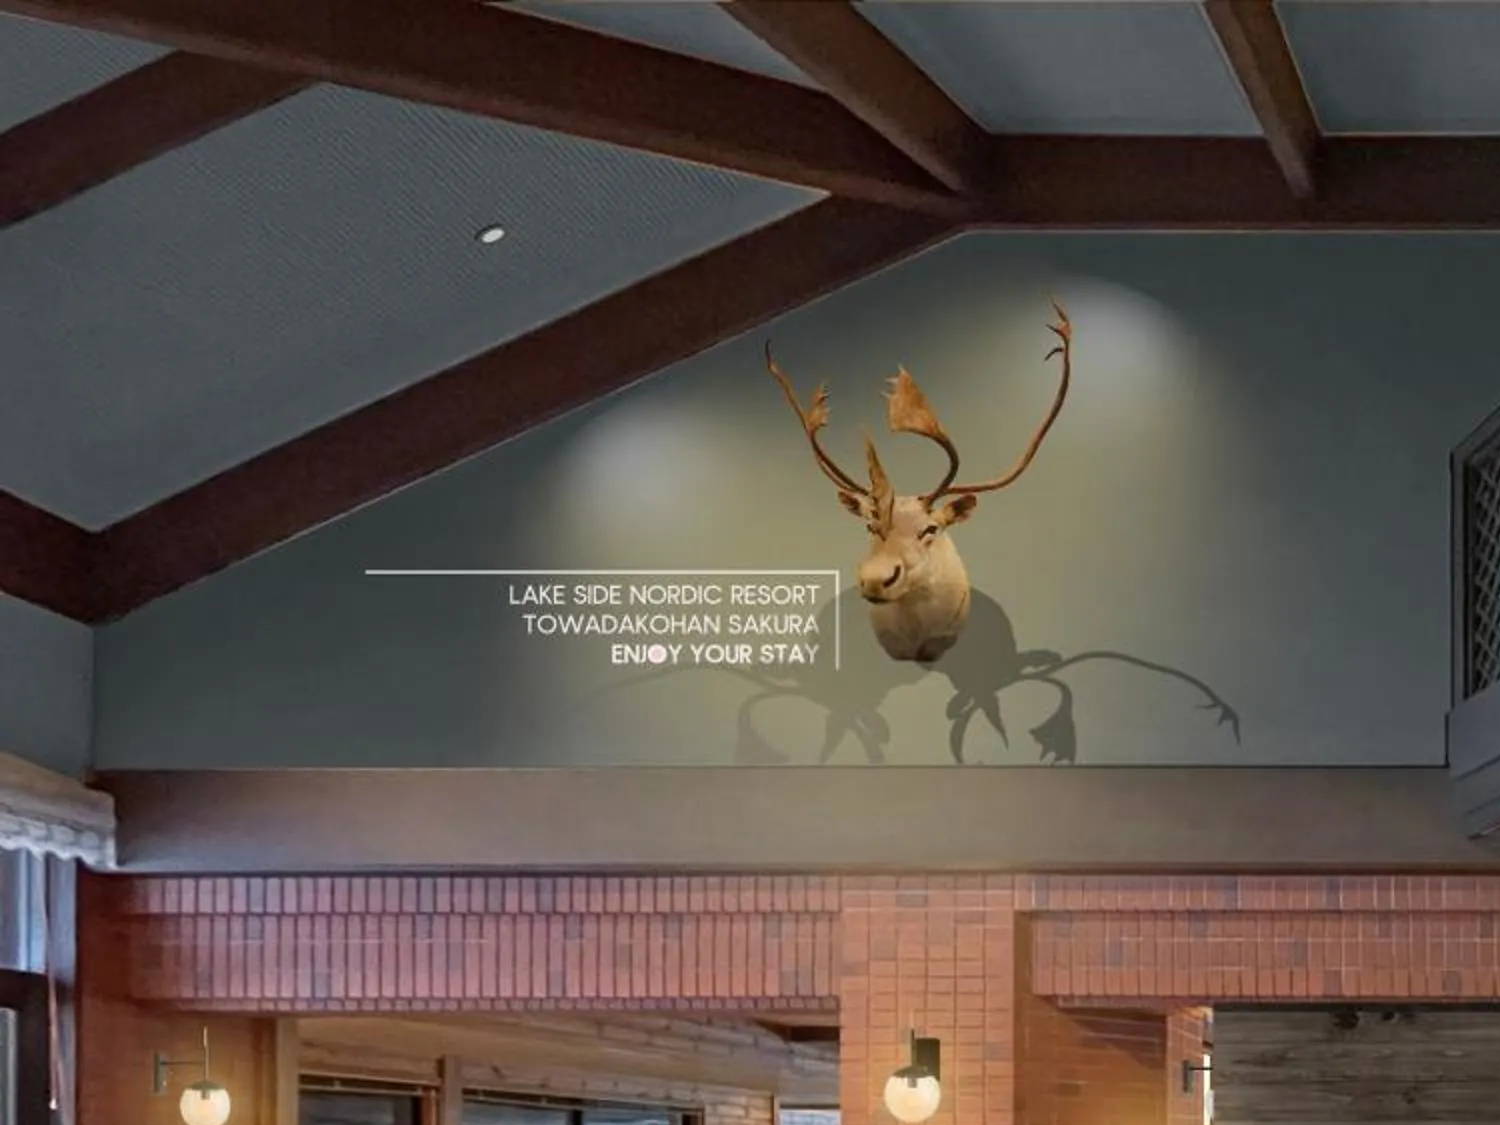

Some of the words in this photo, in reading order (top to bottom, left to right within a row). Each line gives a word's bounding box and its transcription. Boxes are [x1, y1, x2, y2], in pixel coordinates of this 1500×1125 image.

[508, 584, 566, 606] LAKE
[572, 584, 622, 606] SIDE
[629, 584, 723, 606] NORDIC
[730, 584, 822, 606] RESORT
[522, 614, 721, 635] TOWADAKOHAN
[727, 614, 820, 635] SAKURA
[611, 644, 682, 664] ENJOY
[690, 644, 753, 664] YOUR
[760, 644, 820, 664] STAY
